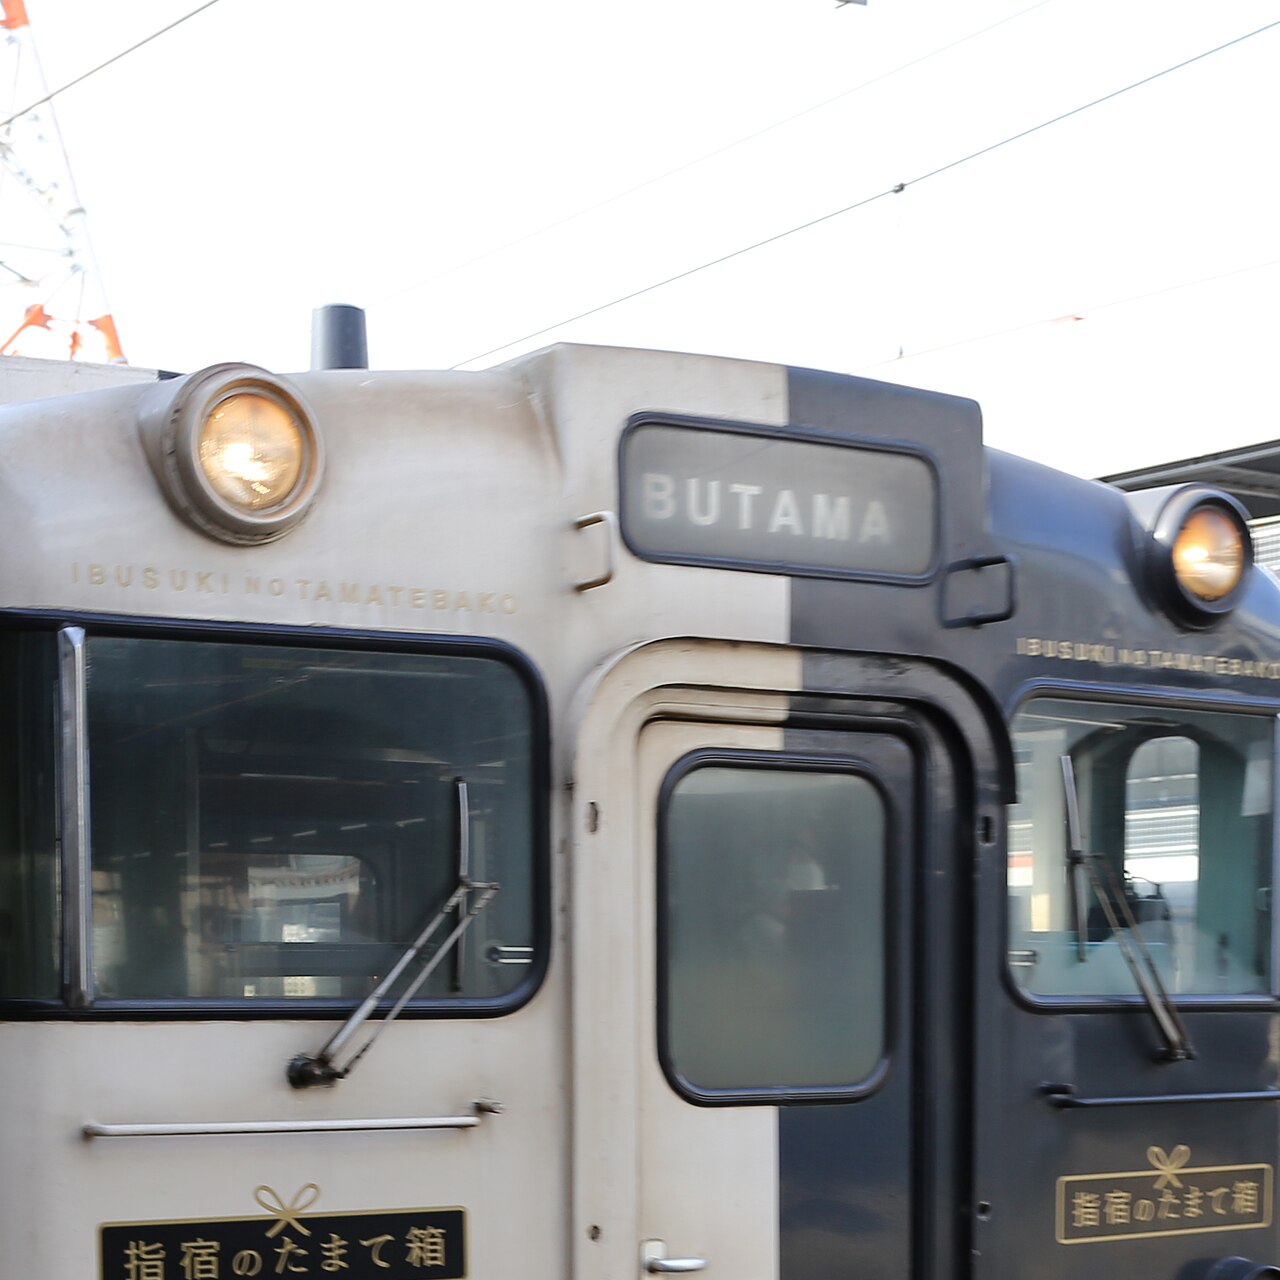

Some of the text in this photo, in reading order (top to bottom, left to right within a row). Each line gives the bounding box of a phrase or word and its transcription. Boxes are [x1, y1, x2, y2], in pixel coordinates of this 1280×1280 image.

[641, 471, 894, 545] BUTAMA
[71, 562, 518, 616] IBUSUKI NO TAMATEBAKO
[1016, 636, 1115, 664] IBUSUKI
[1071, 1179, 1260, 1229] 指宿のたまて箱
